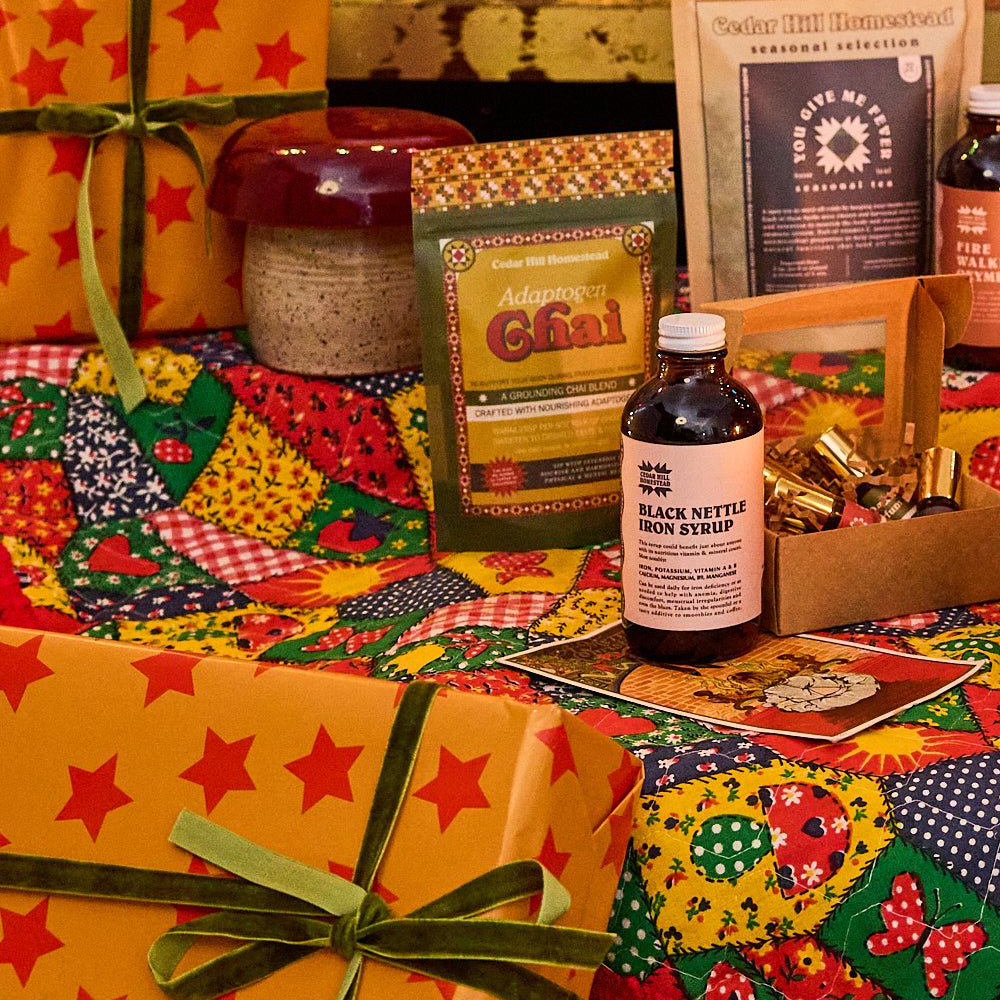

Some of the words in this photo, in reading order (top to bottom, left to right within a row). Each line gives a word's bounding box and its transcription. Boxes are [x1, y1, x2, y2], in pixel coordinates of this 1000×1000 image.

[712, 15, 778, 36] Cedar
[782, 12, 824, 34] Hill
[829, 7, 955, 33] Homestead
[751, 41, 828, 55] seasonal
[837, 37, 920, 51] selection
[793, 126, 807, 164] YOU
[800, 89, 836, 121] GIVE
[842, 88, 867, 107] ME
[867, 103, 893, 160] FEVER
[956, 241, 991, 255] FIRE
[491, 259, 523, 270] Cedar
[526, 256, 545, 267] Hill
[547, 250, 609, 265] Homestead
[498, 284, 606, 307] Adaptogen
[486, 299, 626, 362] Chai
[501, 392, 507, 401] A
[509, 386, 564, 400] GROUNDING
[566, 384, 587, 394] CHAI
[588, 380, 617, 392] BLEND
[475, 407, 513, 418] CRAFTED
[515, 405, 536, 415] WITH
[538, 400, 589, 413] NOURISHING
[640, 471, 656, 479] CEDAR
[640, 478, 671, 487] HOMESTEAD
[638, 503, 687, 520] BLACK
[691, 499, 746, 520] NETTLE
[639, 518, 675, 535] IRON
[679, 519, 734, 536] SYRUP
[694, 566, 720, 574] VITAMIN
[696, 595, 732, 604] irregularities
[710, 601, 732, 610] spoonful
